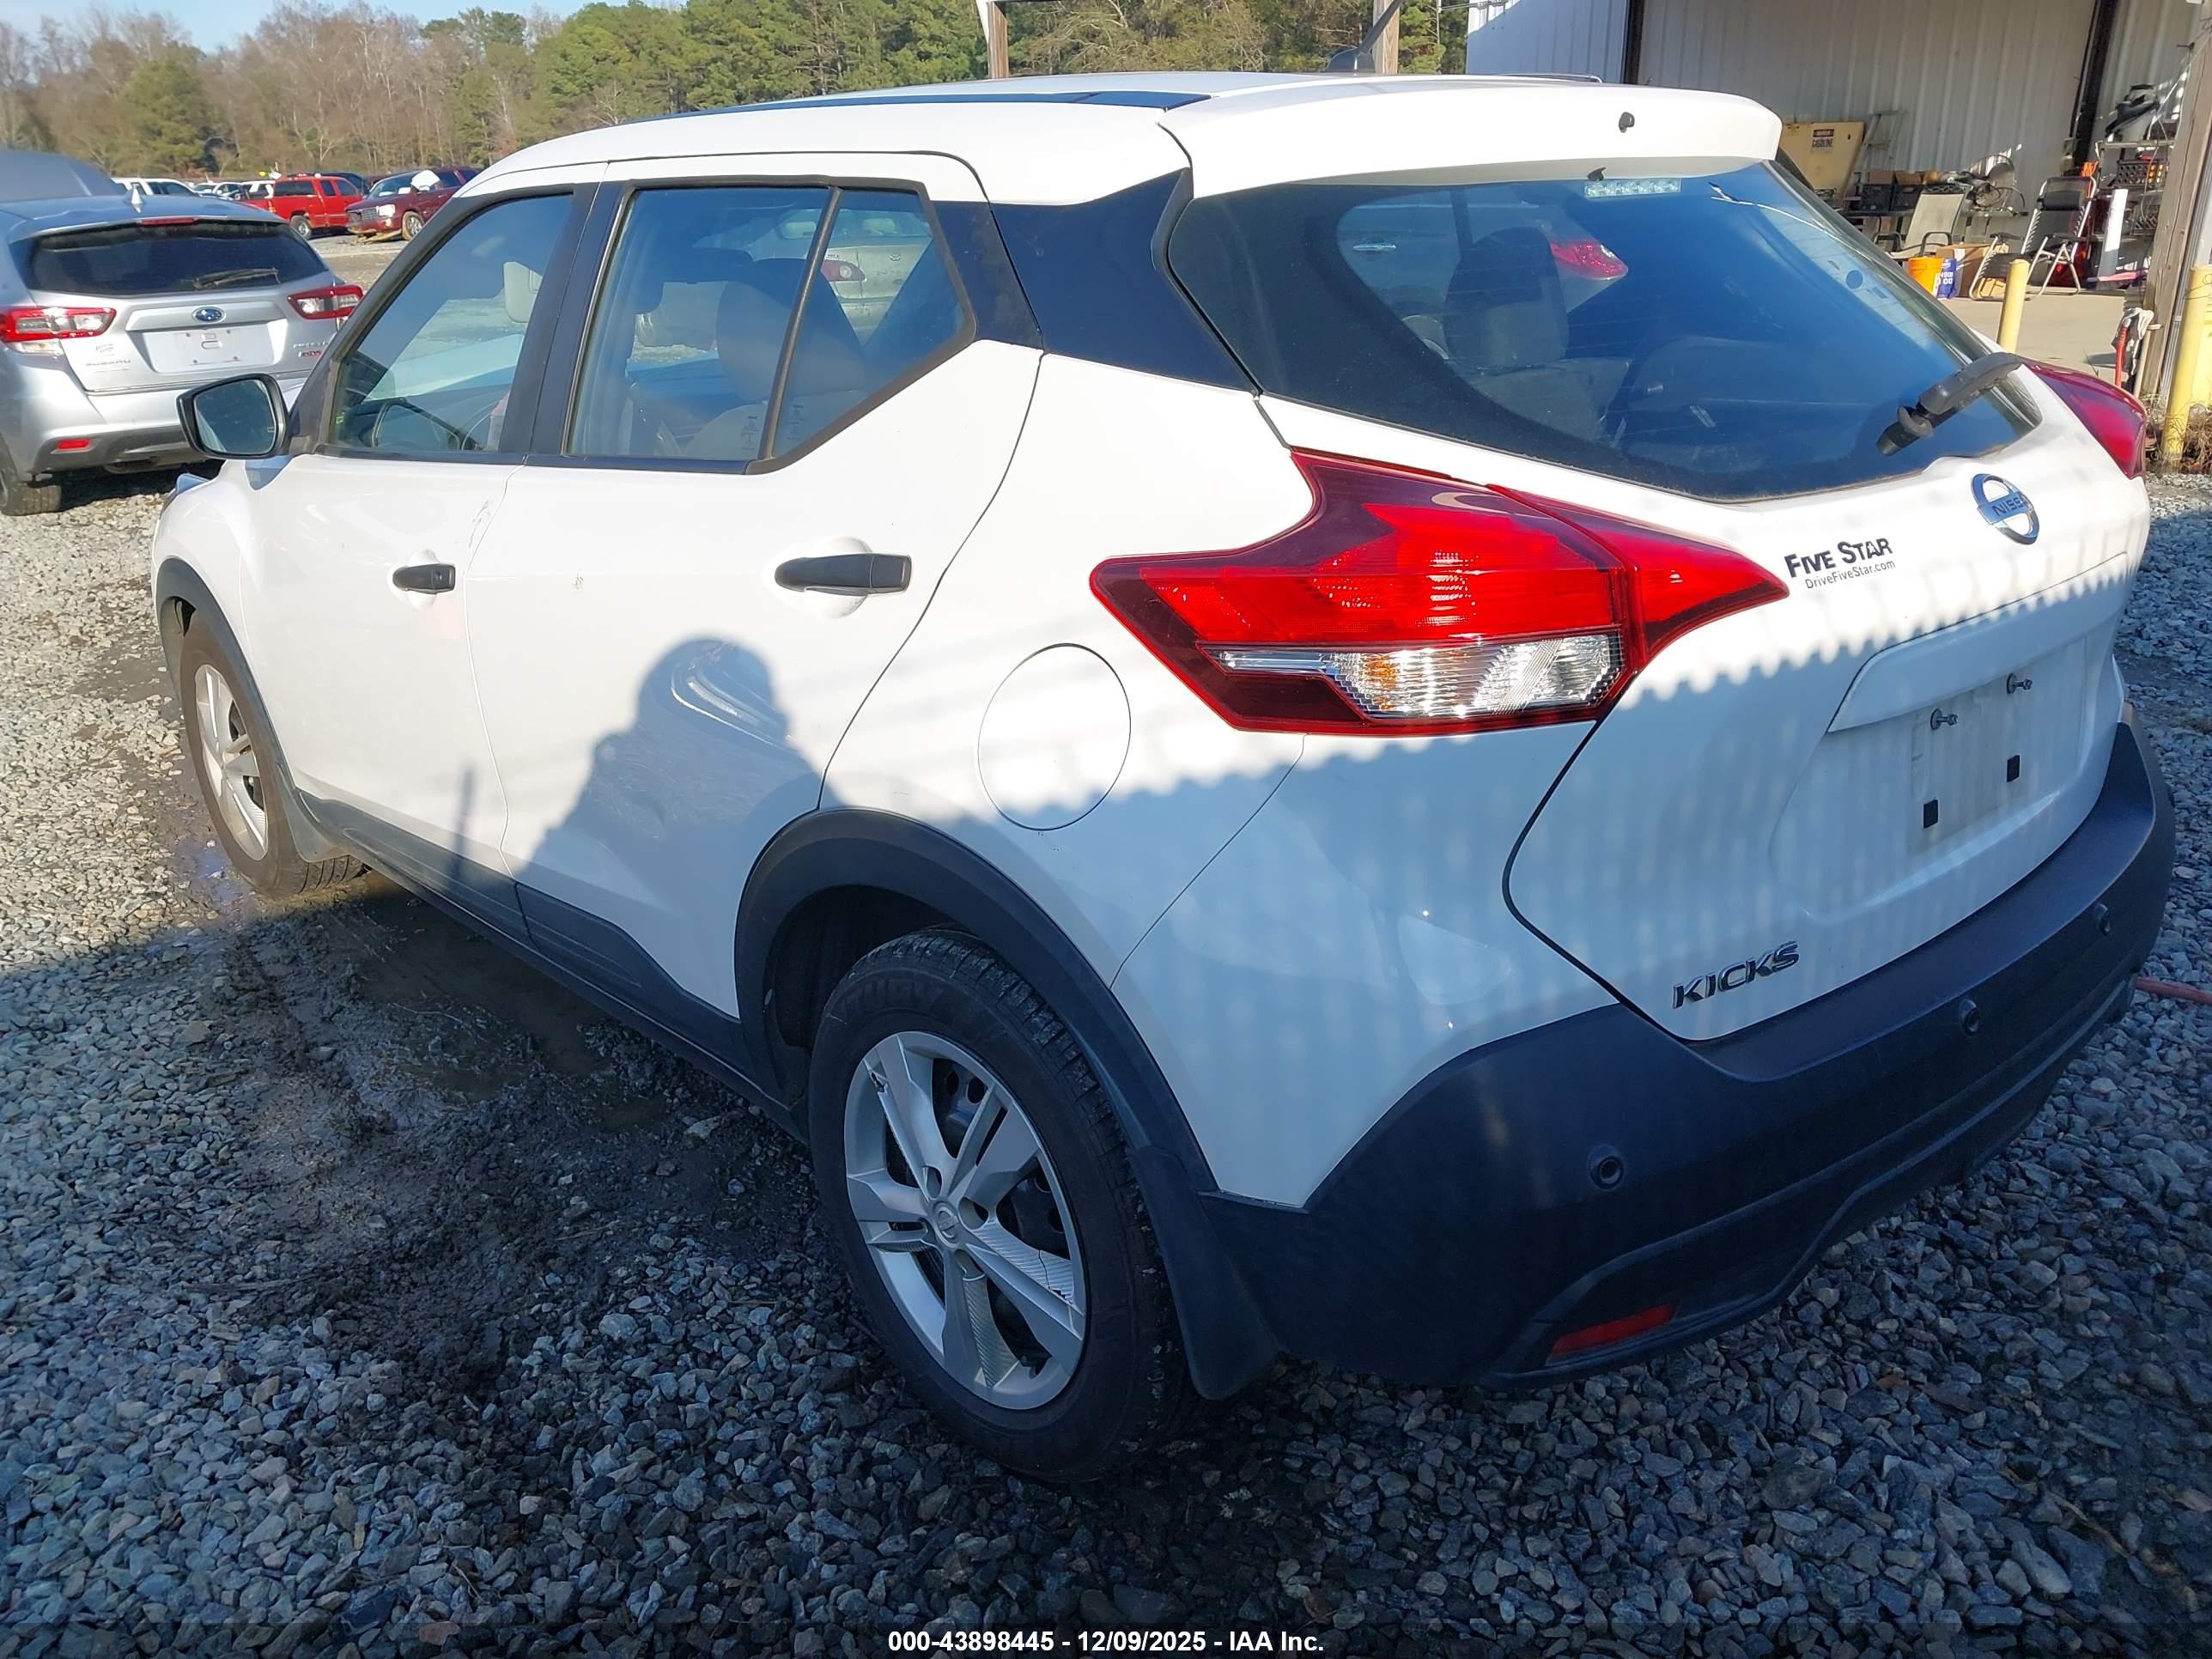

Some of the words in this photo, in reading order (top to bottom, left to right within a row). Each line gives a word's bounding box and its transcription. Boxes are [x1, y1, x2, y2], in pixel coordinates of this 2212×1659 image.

[1784, 552, 1837, 578] FIVE
[1837, 538, 1893, 564] STAR
[1805, 560, 1896, 589] DriveFiveStar.com
[1672, 940, 1800, 1009] KICKS
